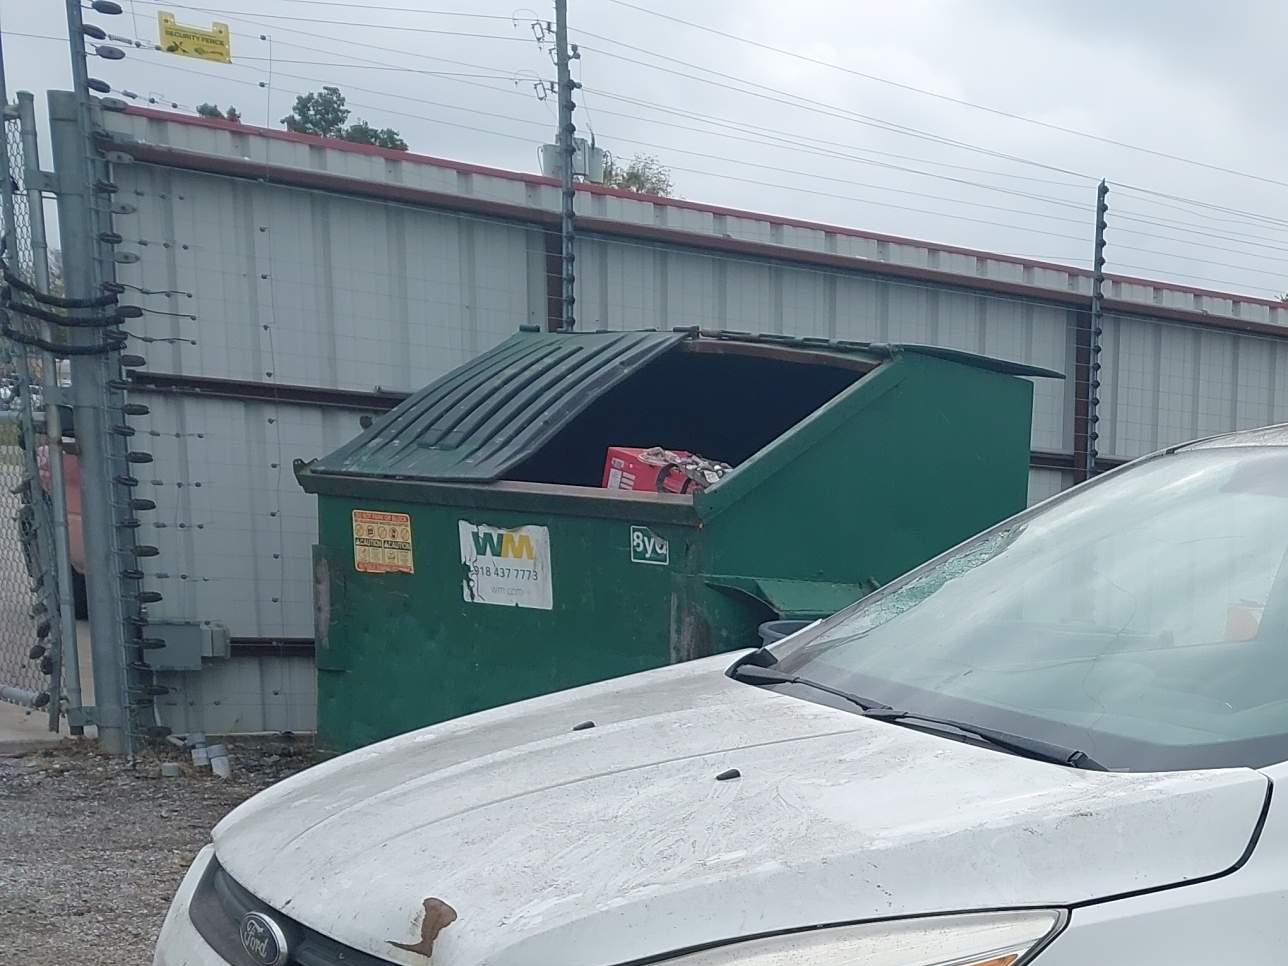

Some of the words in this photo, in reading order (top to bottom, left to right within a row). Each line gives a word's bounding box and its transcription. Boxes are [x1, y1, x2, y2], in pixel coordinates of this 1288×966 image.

[165, 30, 200, 41] SECURITY
[200, 36, 225, 46] FENCE
[471, 530, 534, 561] WM
[474, 566, 491, 577] 918
[494, 567, 511, 578] 437
[513, 568, 538, 581] 7773
[244, 919, 269, 958] Ford
